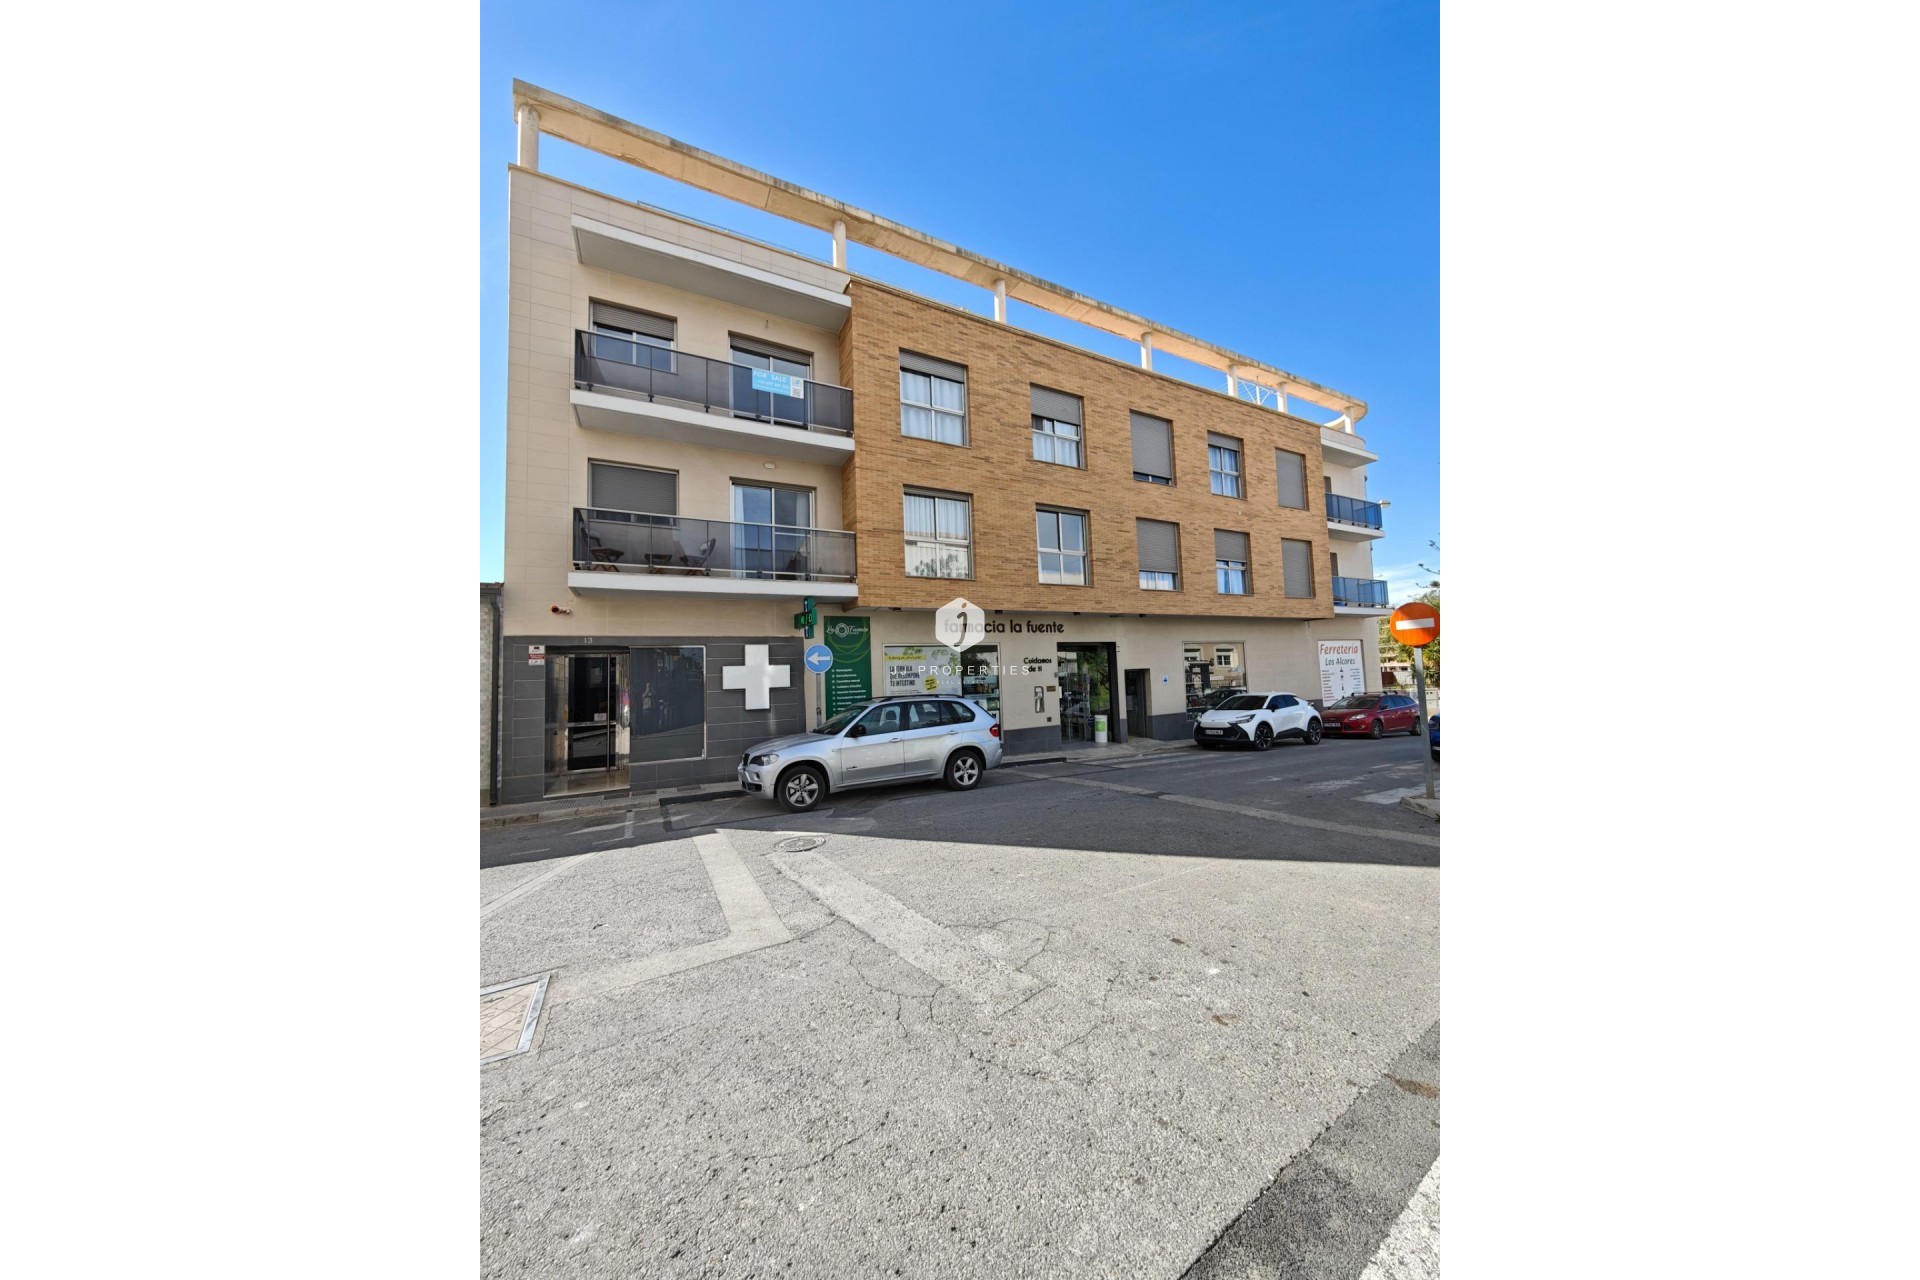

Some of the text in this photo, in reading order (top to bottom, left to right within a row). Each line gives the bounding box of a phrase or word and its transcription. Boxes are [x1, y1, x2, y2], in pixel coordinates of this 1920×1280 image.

[1010, 619, 1022, 633] la
[1026, 620, 1065, 633] fuente
[1023, 657, 1052, 665] Cuidamos
[1325, 658, 1335, 666] Los
